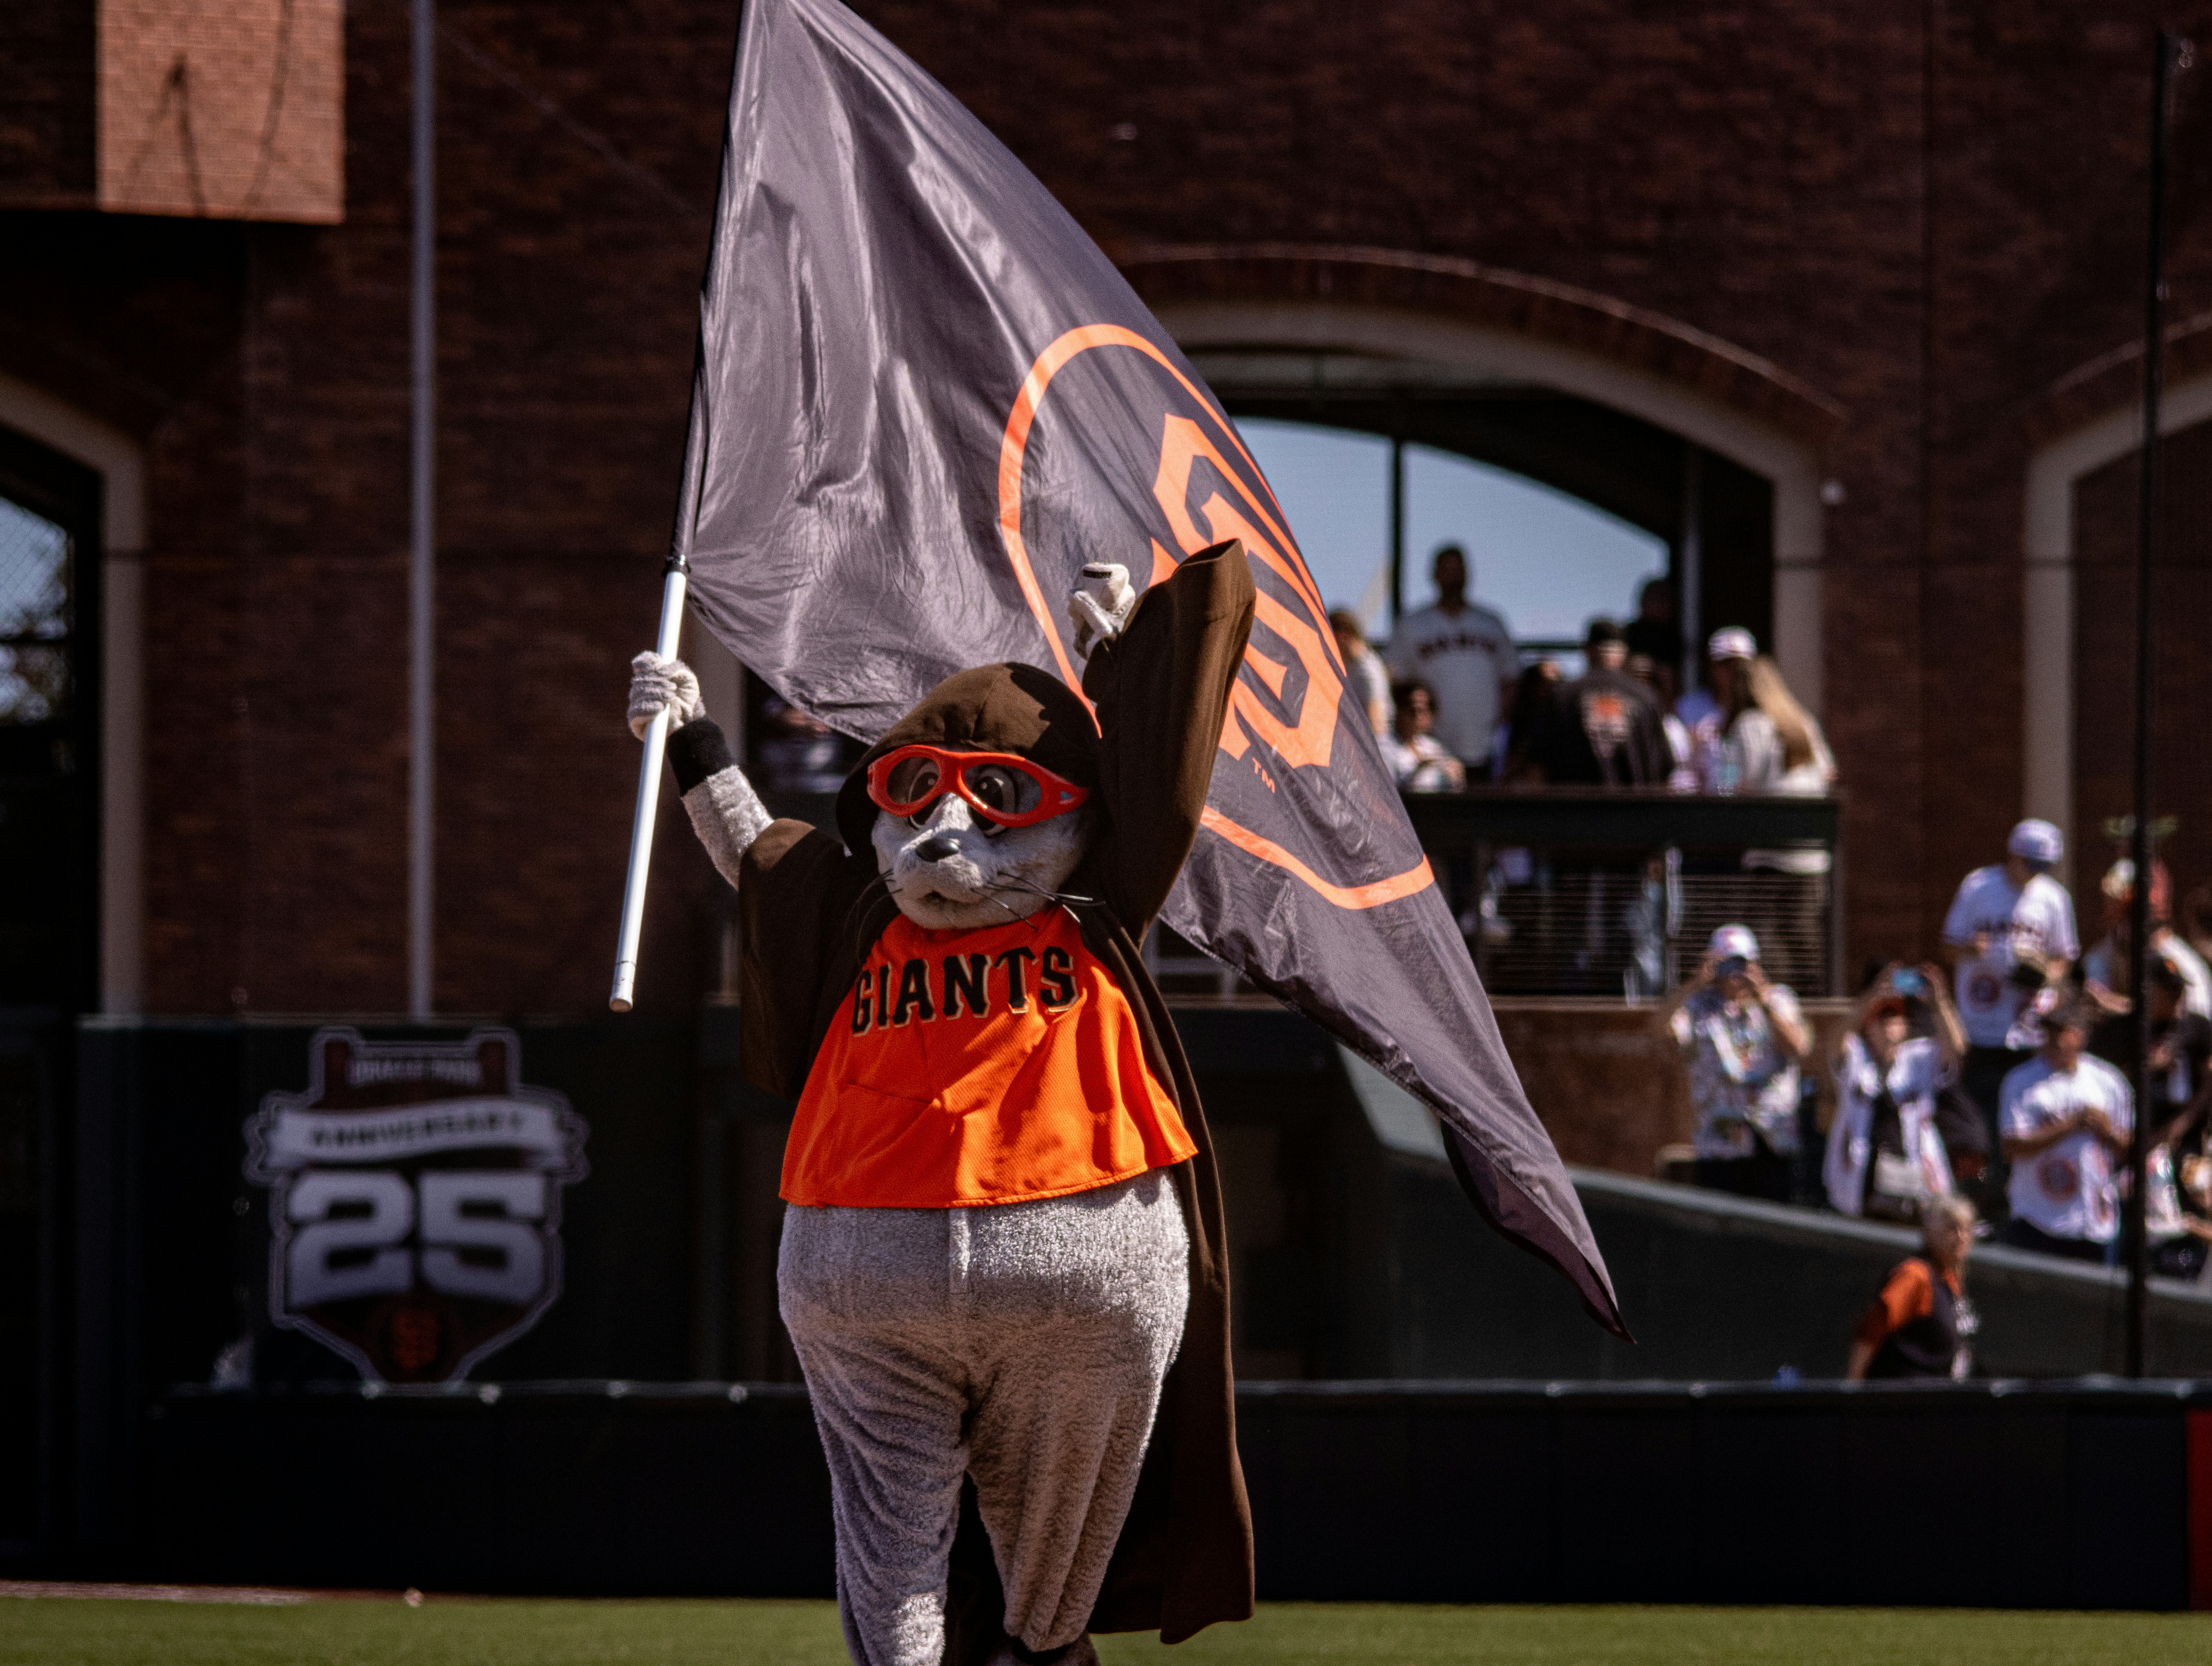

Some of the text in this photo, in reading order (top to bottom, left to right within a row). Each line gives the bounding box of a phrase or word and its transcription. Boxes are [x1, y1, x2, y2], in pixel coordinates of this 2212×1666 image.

[1252, 757, 1275, 794] TM
[851, 946, 1079, 1037] GIANTS
[312, 1111, 526, 1148] ANNIVERSARY
[286, 1168, 547, 1308] 25
